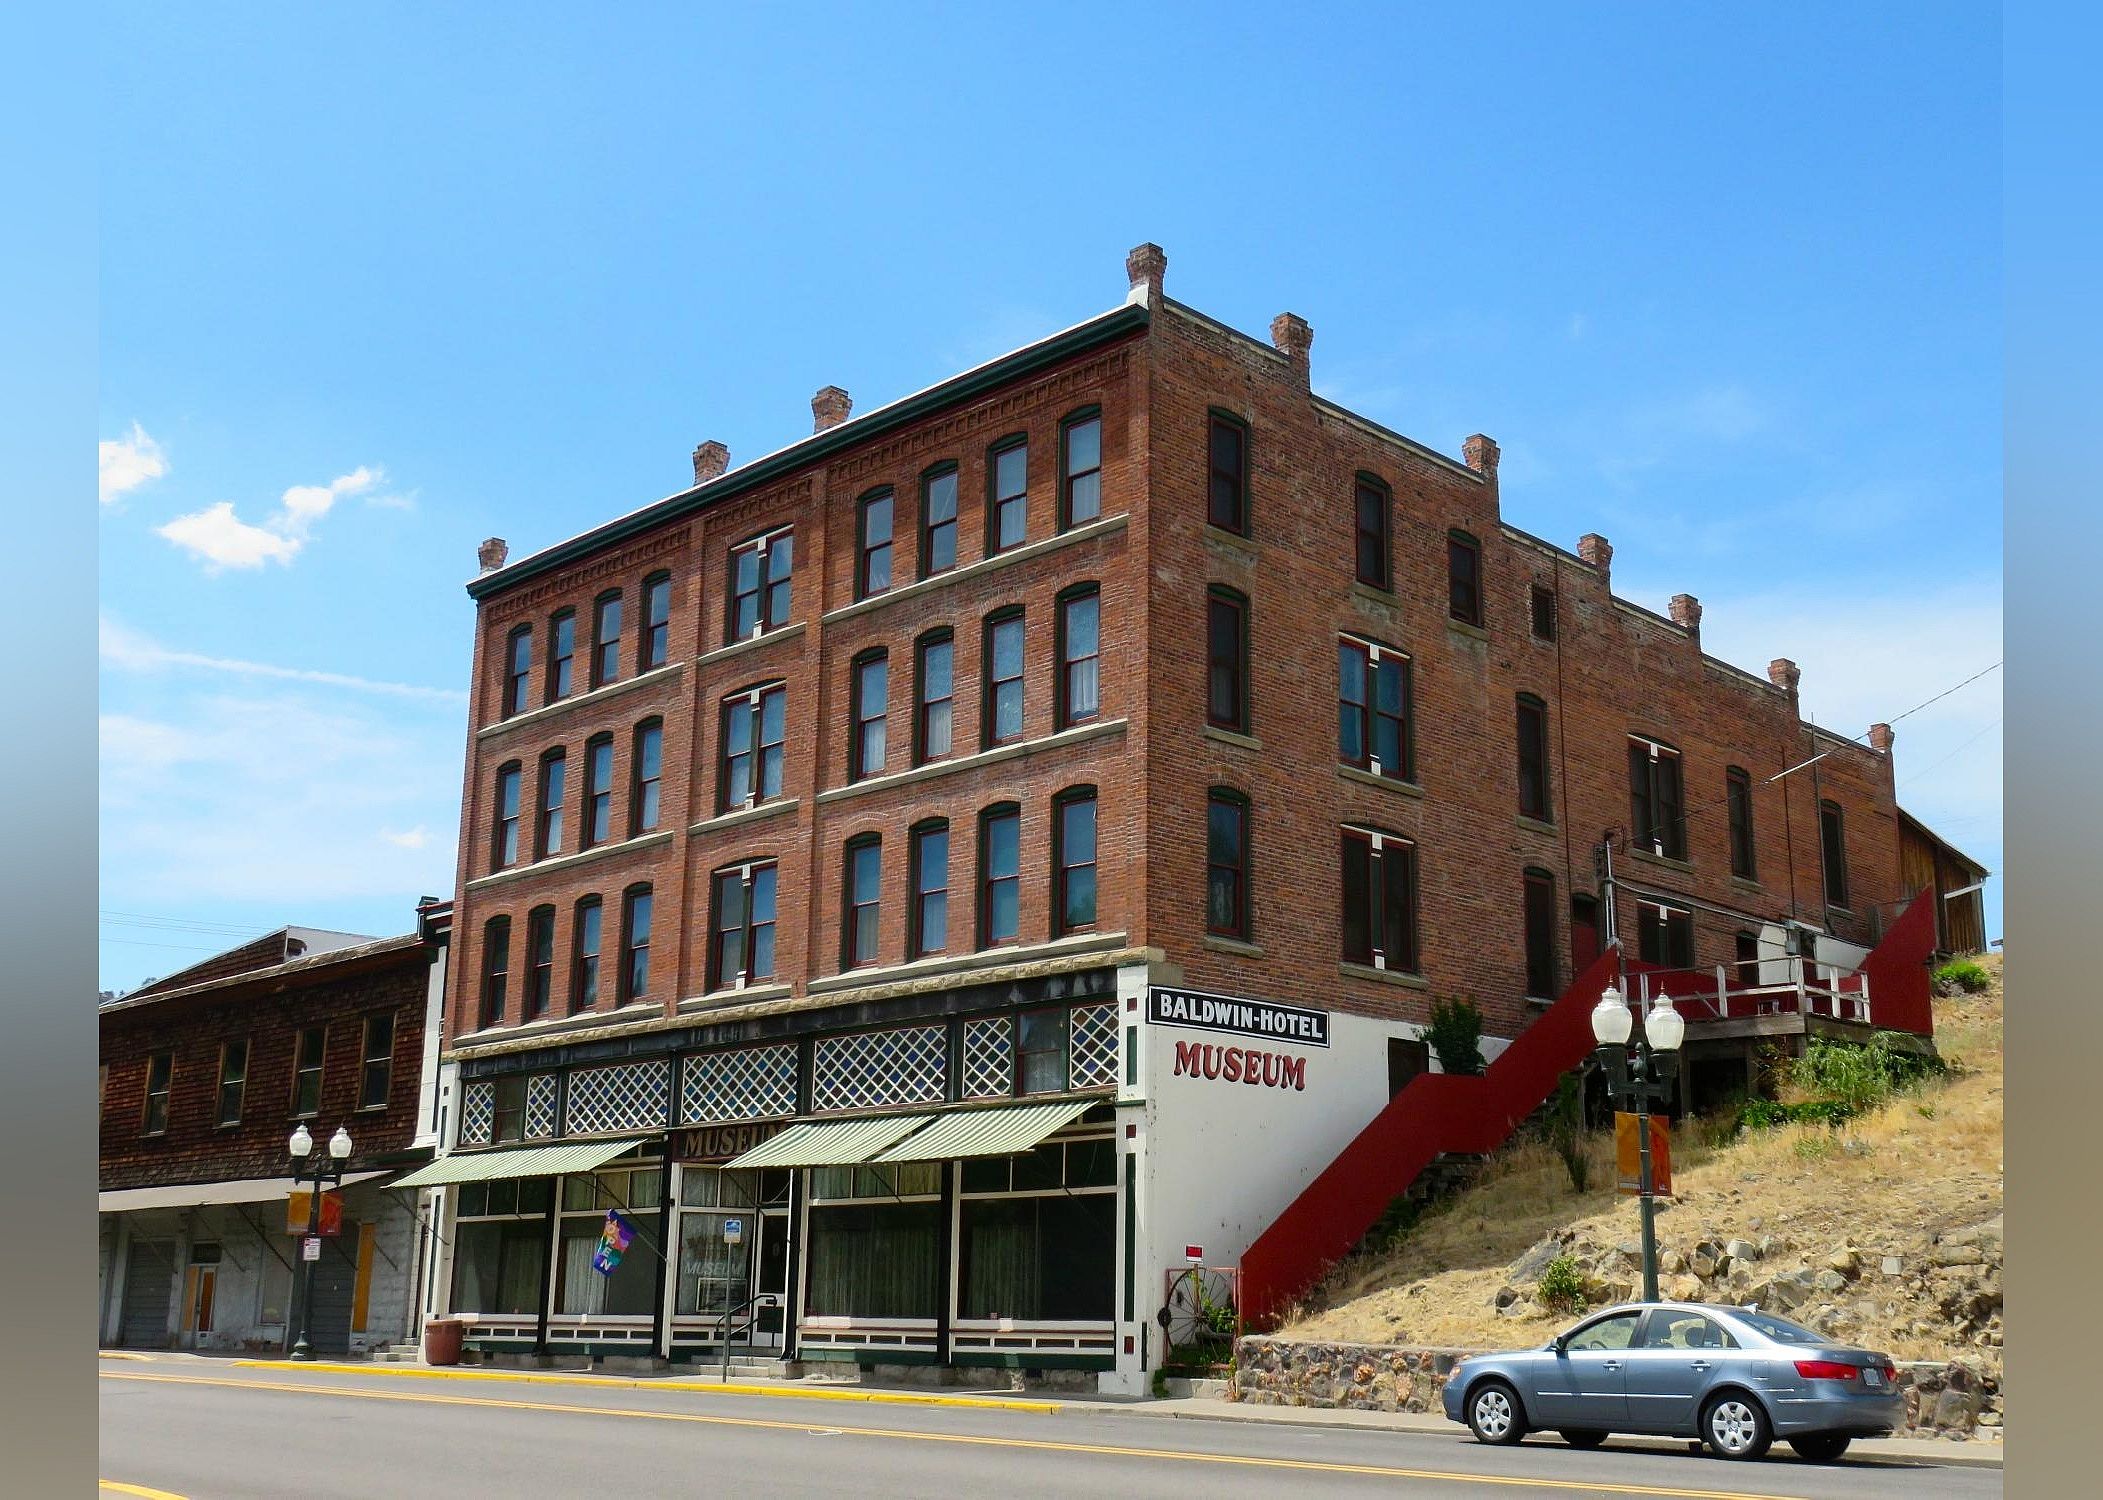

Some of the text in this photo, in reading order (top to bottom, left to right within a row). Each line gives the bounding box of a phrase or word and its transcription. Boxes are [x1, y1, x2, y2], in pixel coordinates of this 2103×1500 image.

[1160, 993, 1323, 1039] BALDWIN-HOTEL
[1173, 1040, 1307, 1092] MUSEUM
[600, 1221, 617, 1271] OPEN
